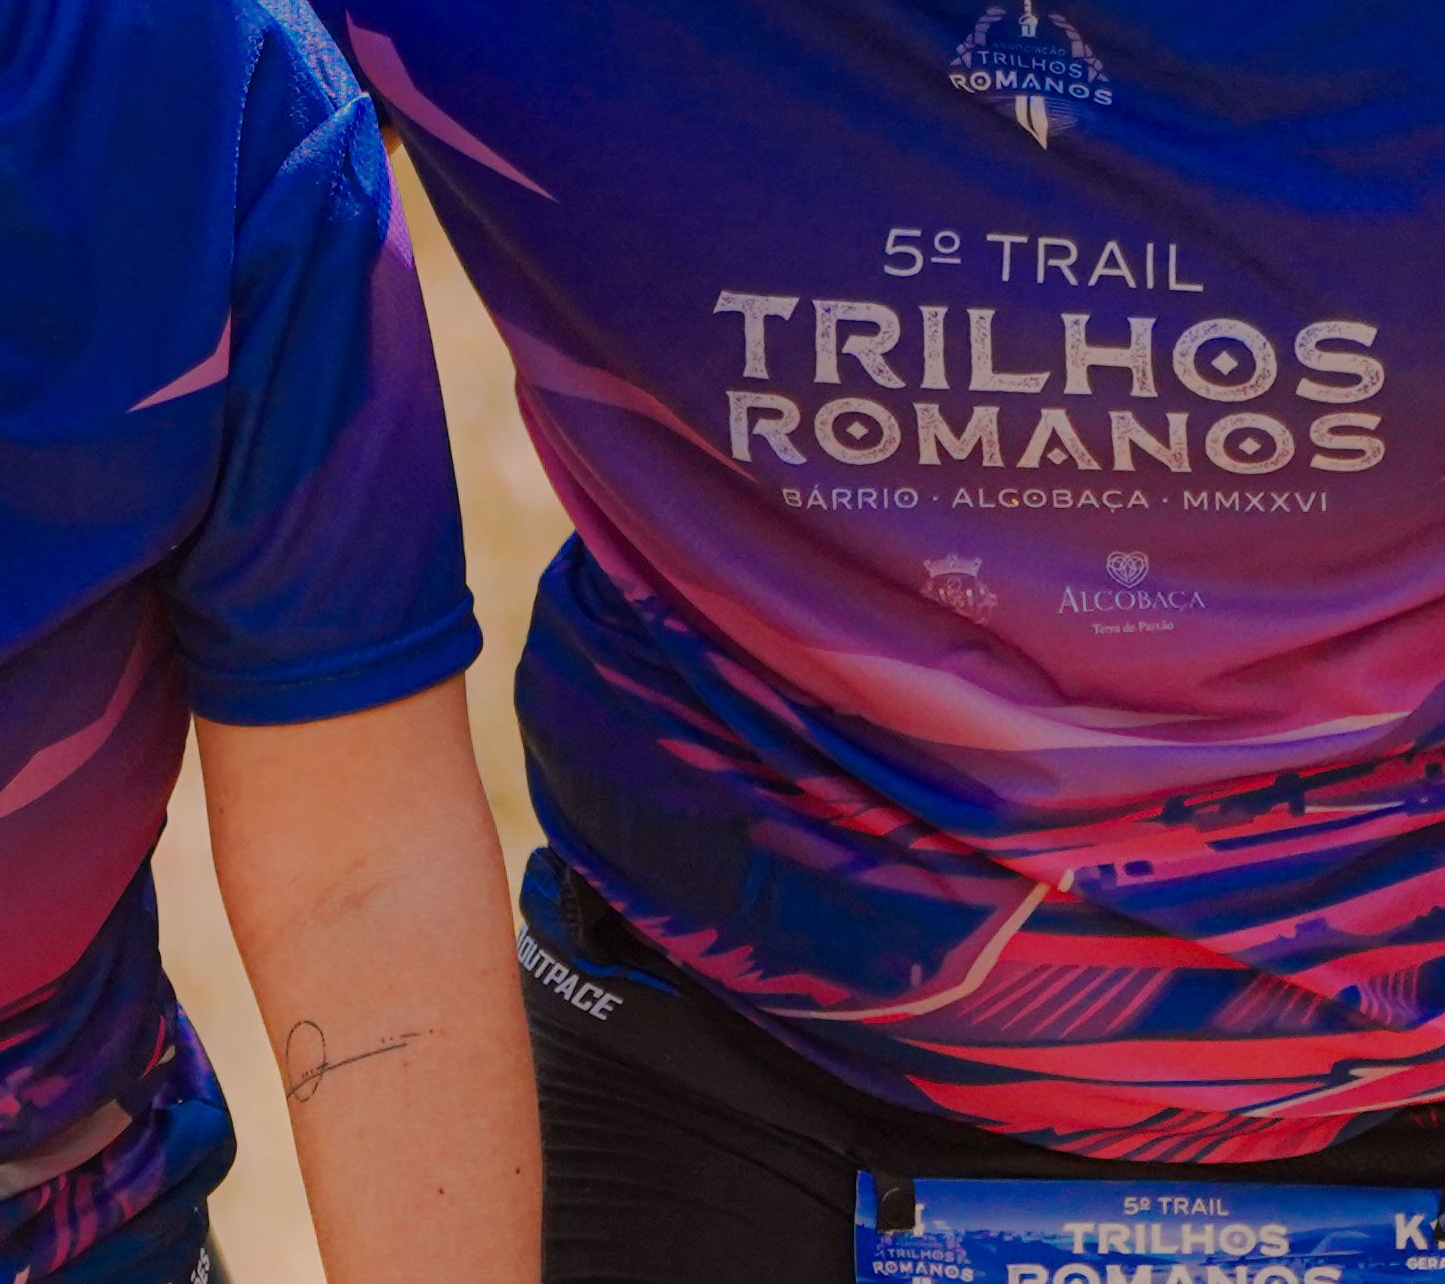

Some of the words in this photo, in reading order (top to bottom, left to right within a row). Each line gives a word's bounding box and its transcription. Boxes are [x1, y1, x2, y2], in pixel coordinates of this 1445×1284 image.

[977, 50, 1083, 79] TRILHOS
[949, 71, 1113, 105] ROMANOS
[883, 227, 962, 276] 5º
[986, 233, 1204, 293] TRAIL
[713, 289, 1386, 404] TRILHOS
[725, 390, 1386, 476] ROMANOS
[782, 484, 918, 510] BÁRRIO
[952, 487, 1149, 514] ALCOBAÇA
[1184, 490, 1327, 513] MMXXVI
[1158, 1196, 1230, 1217] TRAIL
[888, 1248, 954, 1263] TRILHOS
[1063, 1222, 1290, 1257] TRILHOS
[872, 1261, 974, 1283] ROMANOS
